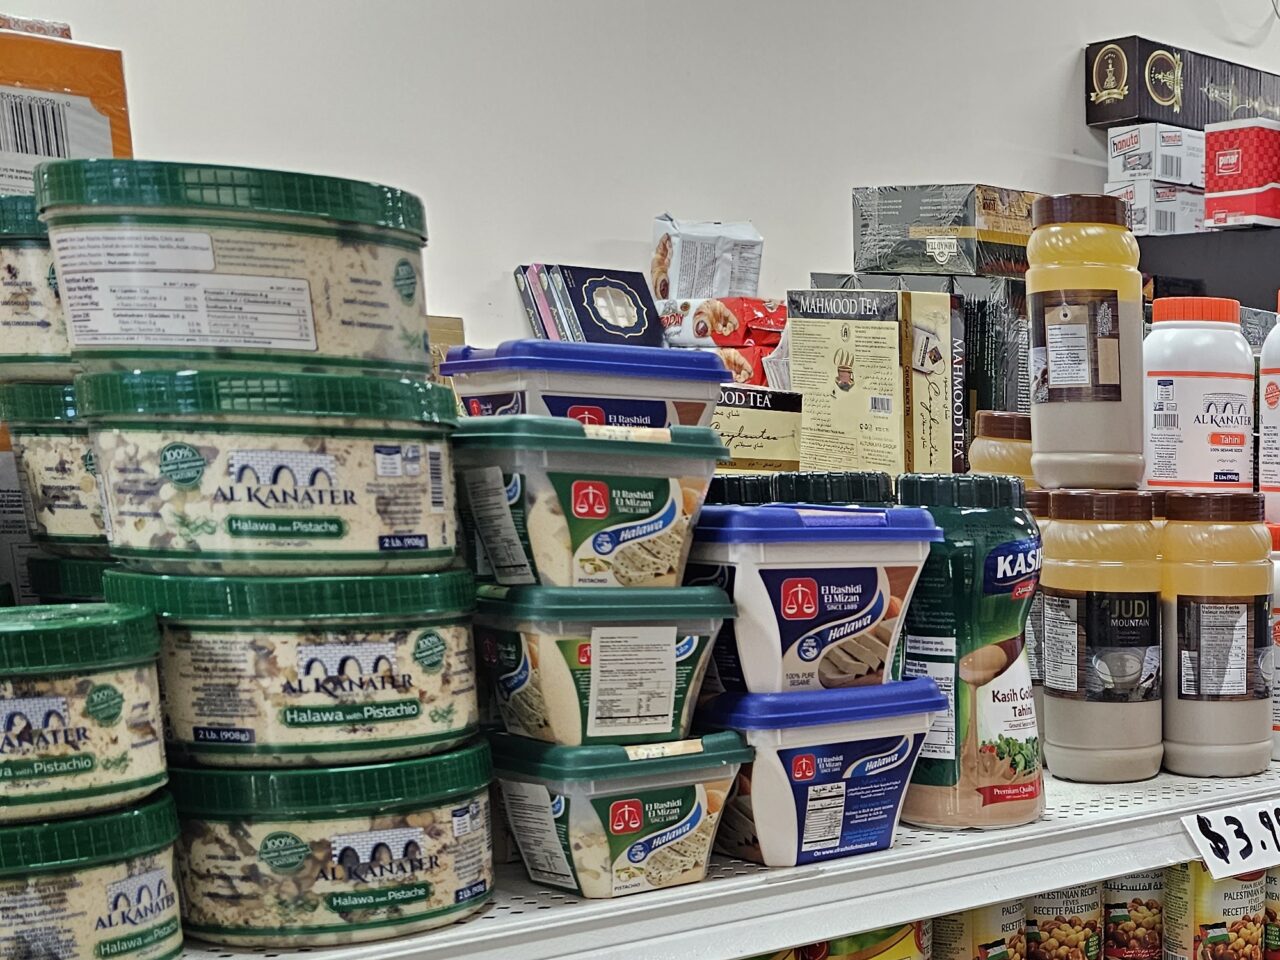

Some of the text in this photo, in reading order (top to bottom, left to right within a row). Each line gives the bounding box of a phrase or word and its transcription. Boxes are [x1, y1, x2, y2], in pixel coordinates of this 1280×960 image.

[1111, 132, 1141, 152] hanuta
[800, 297, 879, 315] MAHMOOD TEA
[952, 337, 964, 425] MAHMOOD
[748, 393, 771, 407] TEA
[1193, 415, 1251, 428] AL KANATER
[1220, 435, 1241, 445] Tahini
[213, 486, 241, 502] AL
[247, 487, 357, 509] KANATER
[232, 520, 339, 533] Halawa Pistache
[620, 519, 663, 541] Halawa
[830, 584, 862, 596] Rashidi
[833, 592, 860, 603] Mizan
[1111, 600, 1149, 619] JUDI
[828, 614, 872, 640] Halawa
[1111, 619, 1149, 628] MOUNTAIN
[282, 673, 412, 699] AL KANATER
[286, 709, 343, 723] Halawa
[363, 702, 418, 719] Pistachio
[865, 752, 899, 772] Halawa
[652, 822, 691, 849] Halawa
[347, 856, 440, 884] KANATER
[332, 886, 425, 907] Halawa Pistache
